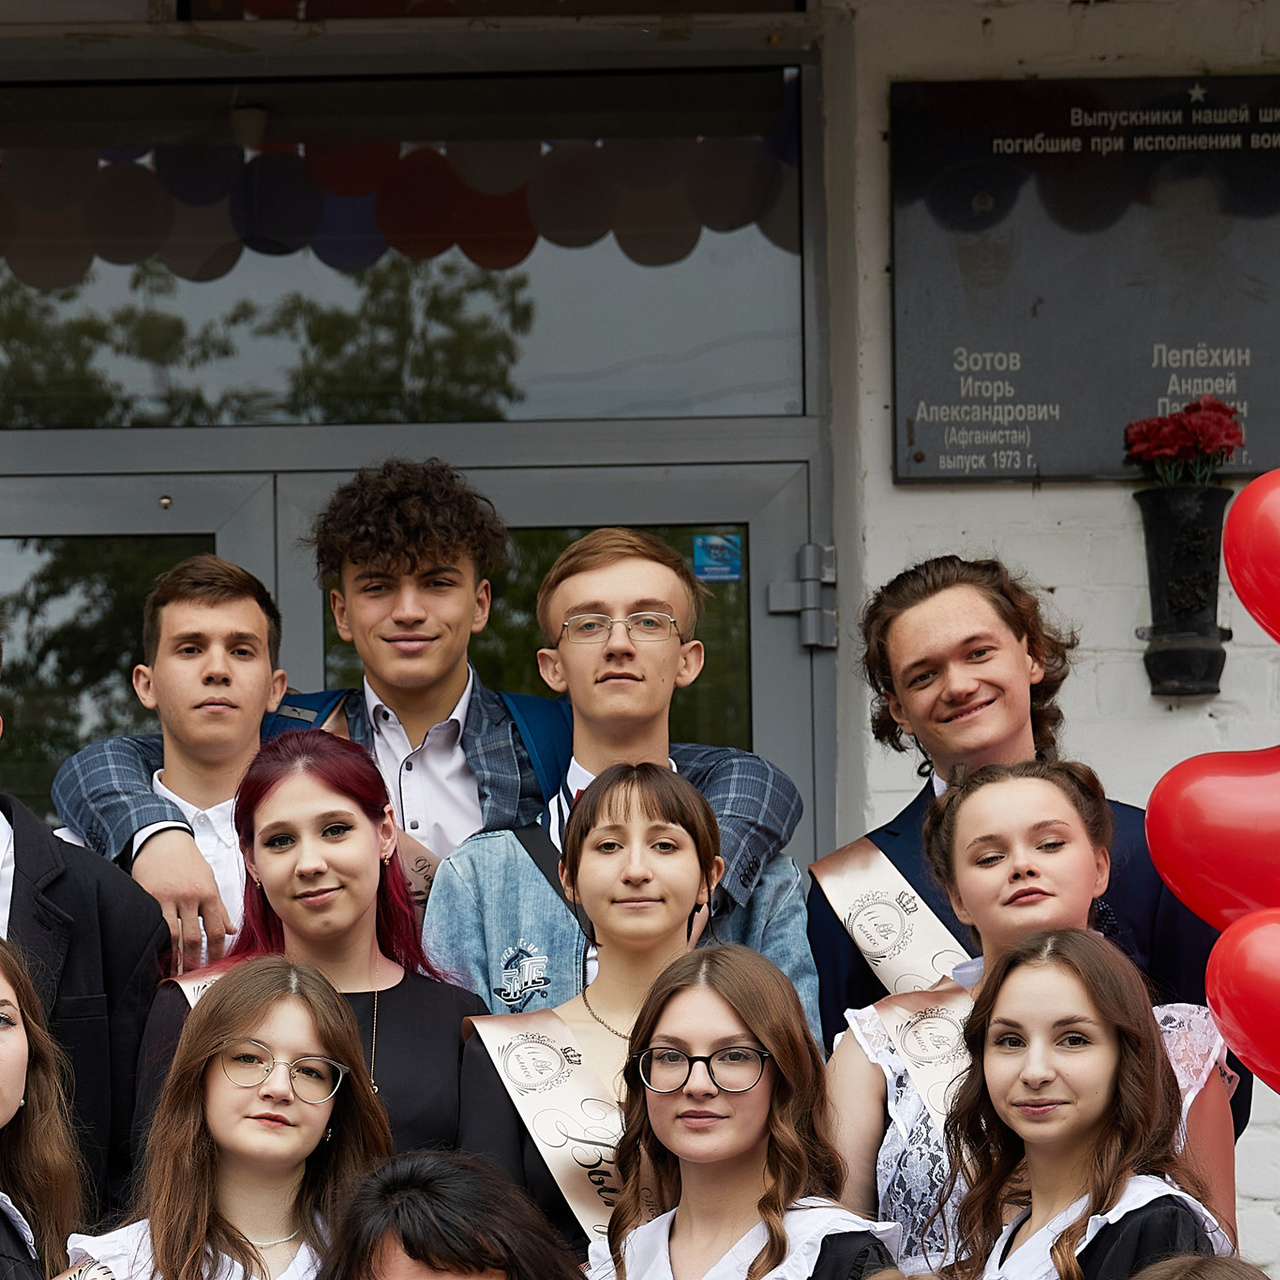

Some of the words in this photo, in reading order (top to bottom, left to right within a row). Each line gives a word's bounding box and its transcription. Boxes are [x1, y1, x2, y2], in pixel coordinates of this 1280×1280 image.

[1070, 107, 1183, 131] Выпускники
[1191, 104, 1250, 125] нашей
[993, 133, 1082, 155] погибшие
[1091, 134, 1124, 156] при
[1134, 131, 1242, 153] исполнении
[953, 346, 1021, 373] Зотов
[1151, 343, 1251, 369] Лепёхин
[960, 375, 1015, 401] Игорь
[1167, 372, 1238, 397] Андрей
[916, 402, 1060, 425] Александрович
[945, 425, 1031, 447] (Афганистан)
[939, 452, 986, 472] выпуск
[992, 451, 1021, 469] 1973
